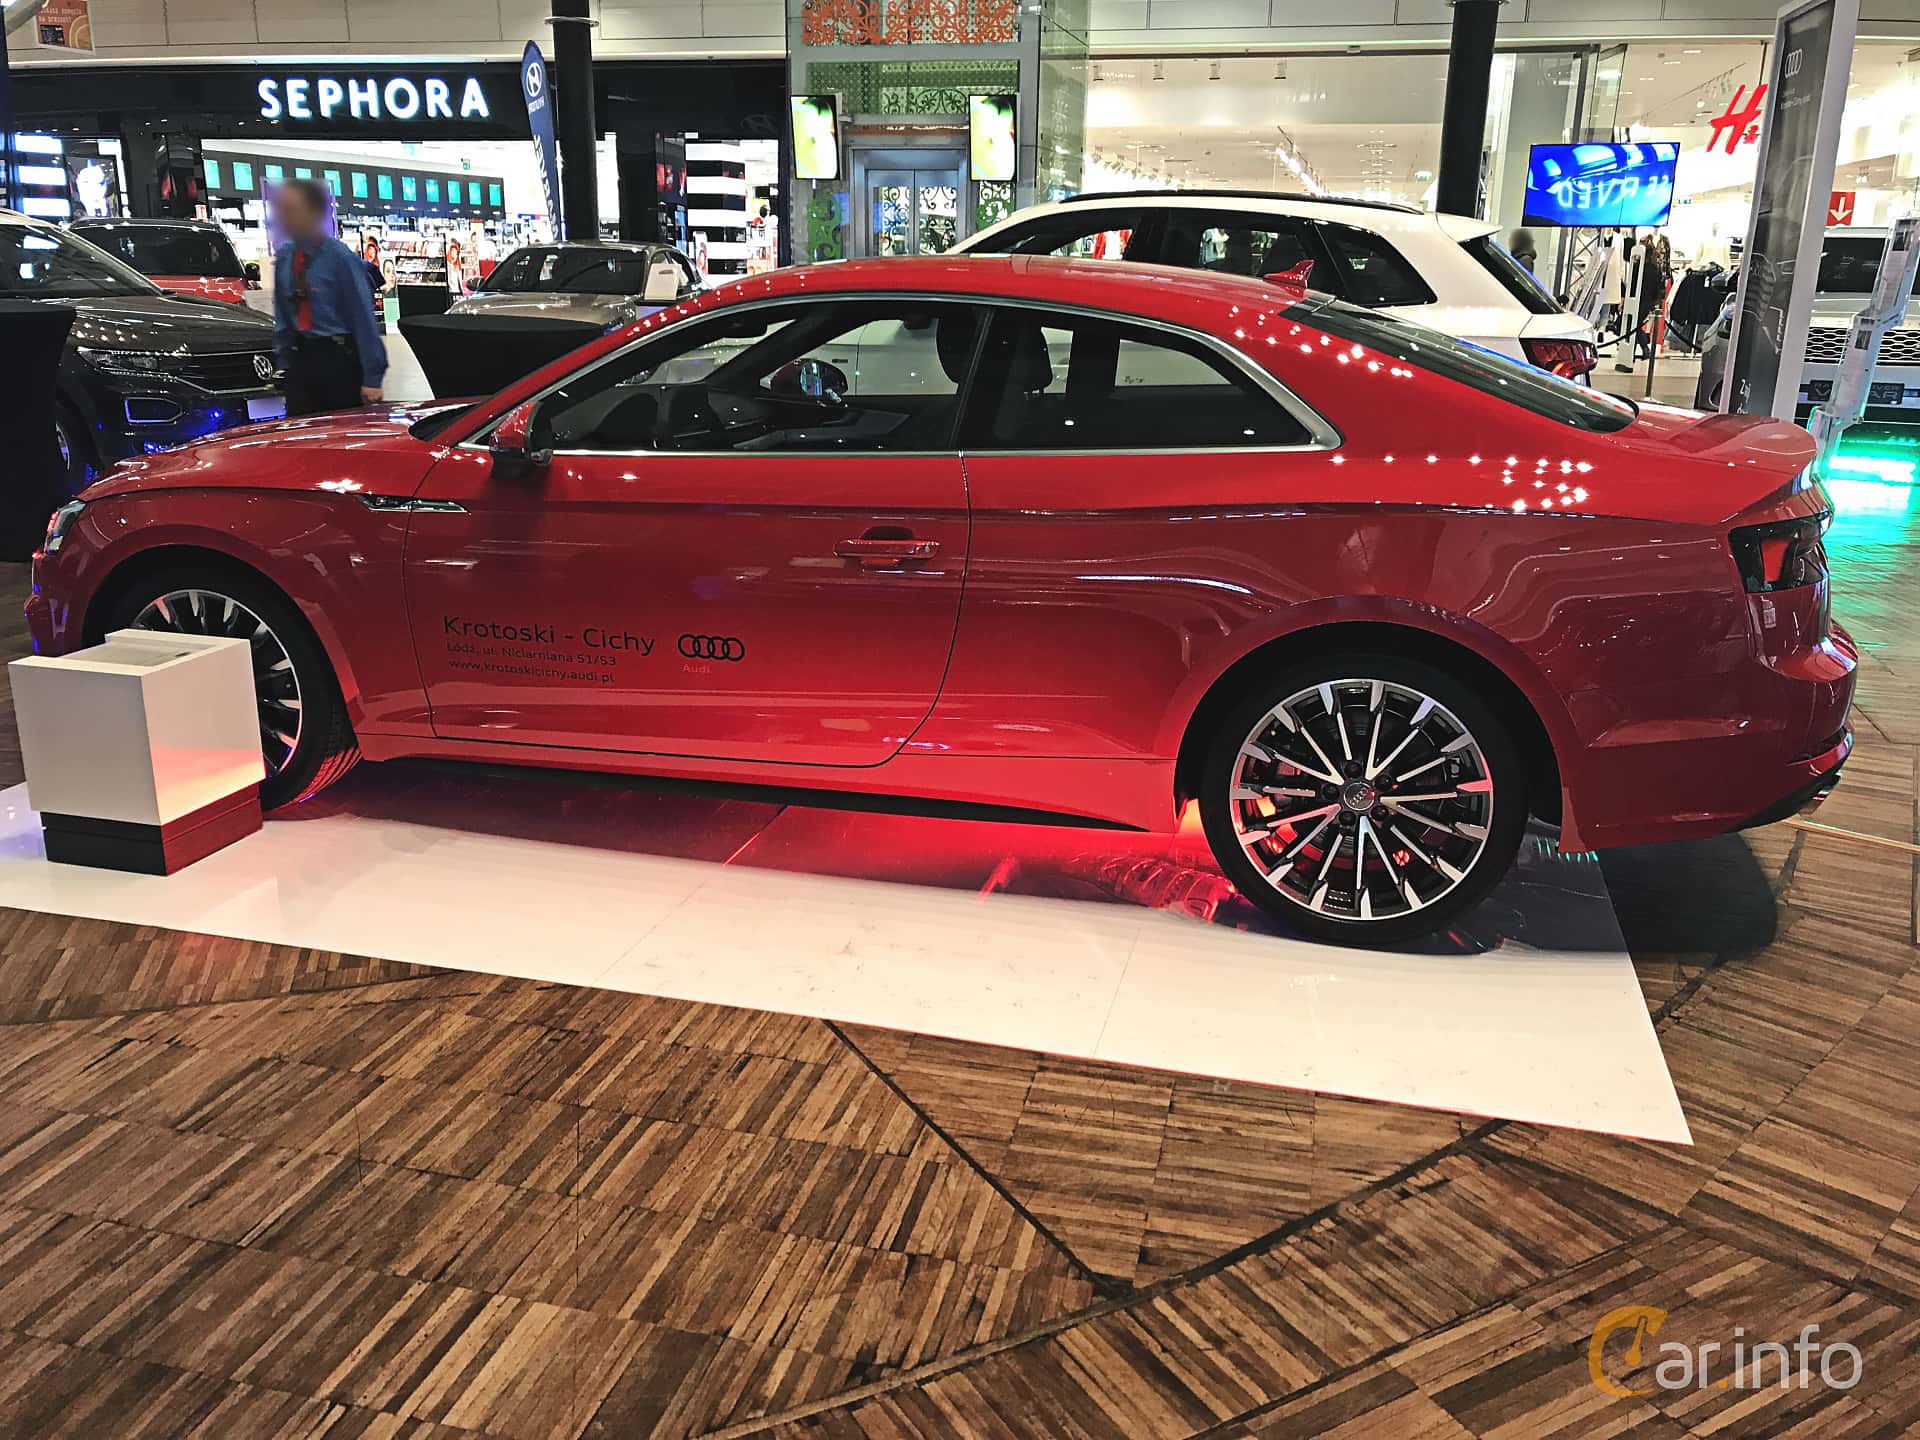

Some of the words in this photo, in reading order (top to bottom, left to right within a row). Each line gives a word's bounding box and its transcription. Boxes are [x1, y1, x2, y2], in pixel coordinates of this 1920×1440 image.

[257, 77, 490, 119] SEPHORA
[1707, 84, 1769, 155] H&
[443, 615, 555, 643] Krotoski
[583, 628, 656, 657] Cichy
